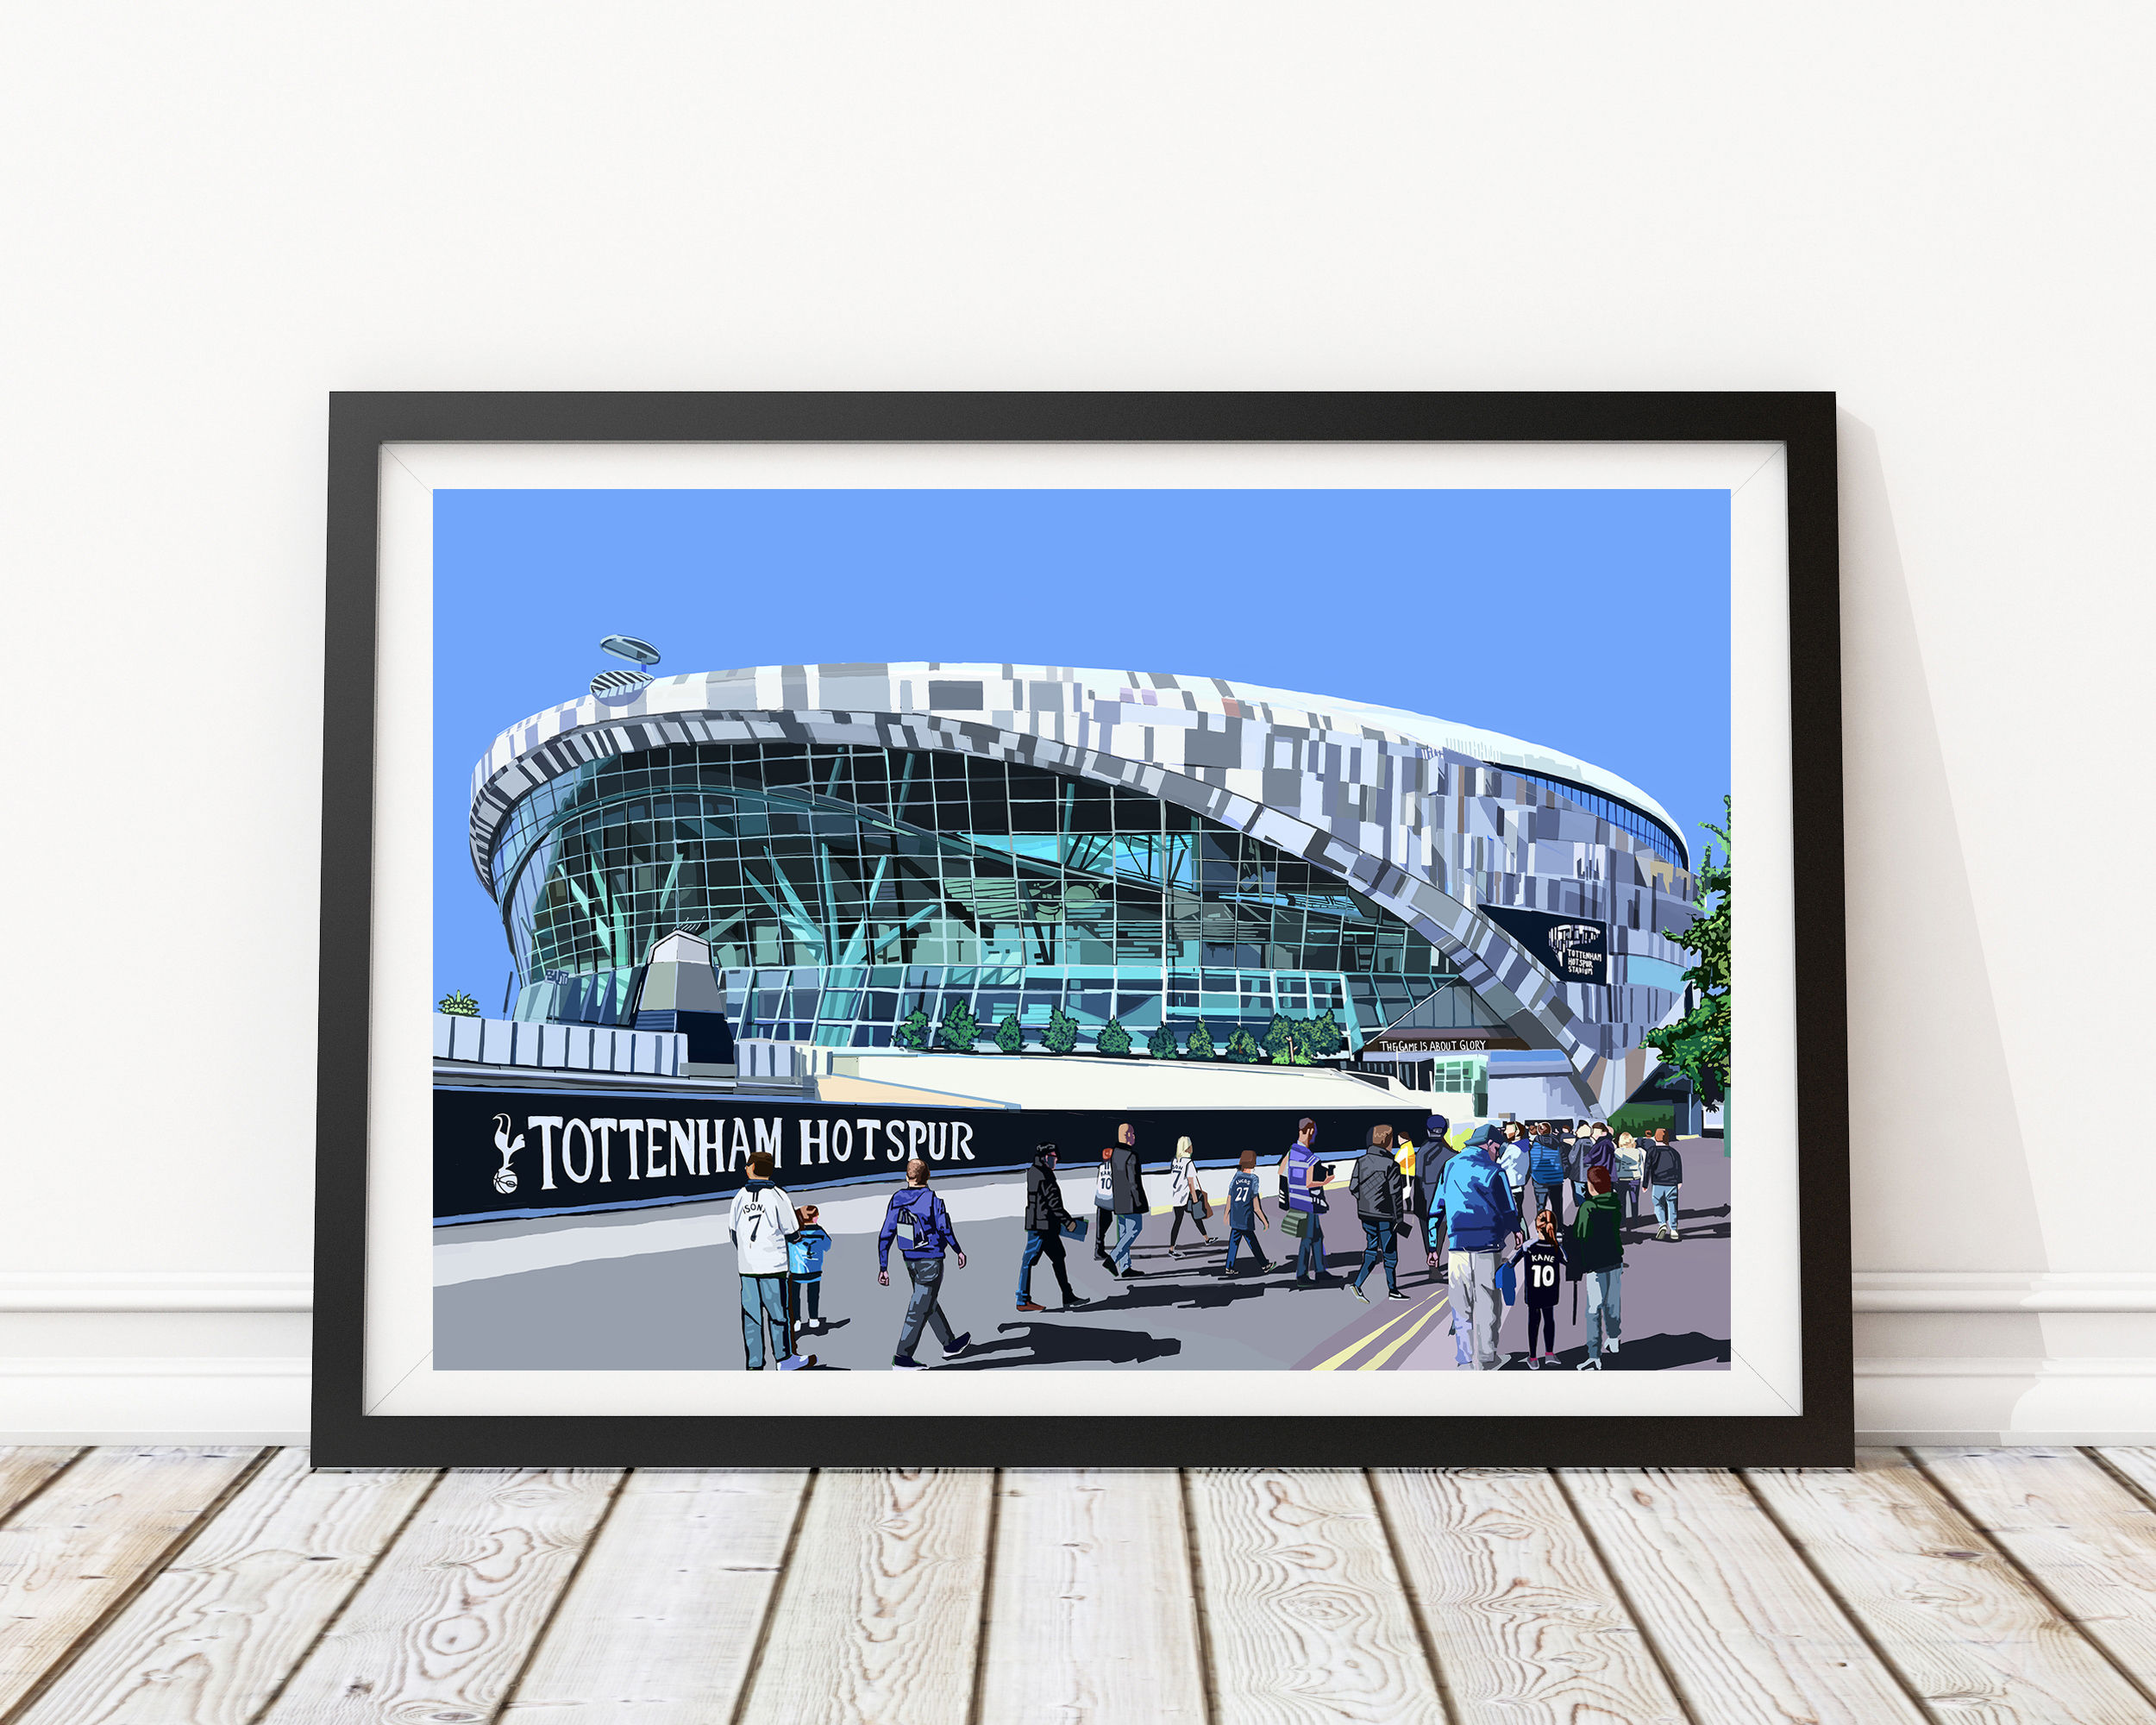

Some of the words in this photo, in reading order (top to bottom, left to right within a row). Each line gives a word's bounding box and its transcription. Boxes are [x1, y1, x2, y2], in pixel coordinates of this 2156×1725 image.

[1567, 949, 1602, 962] TOTTENHAM
[1568, 957, 1594, 969] HOTSPUR
[1568, 966, 1593, 975] STADIUM
[1398, 1040, 1418, 1051] GAME
[1420, 1041, 1428, 1051] IS
[1430, 1041, 1457, 1051] ABOUT
[1459, 1039, 1486, 1051] GLORY
[528, 1116, 783, 1190] TOTTENHAM
[799, 1119, 976, 1164] HOTSPUR
[1100, 1177, 1112, 1190] 10
[1173, 1170, 1182, 1189] 7
[1235, 1187, 1250, 1202] 27
[744, 1203, 763, 1213] SON
[749, 1214, 761, 1242] 7
[1531, 1254, 1555, 1263] KANE
[1531, 1264, 1555, 1288] 10
